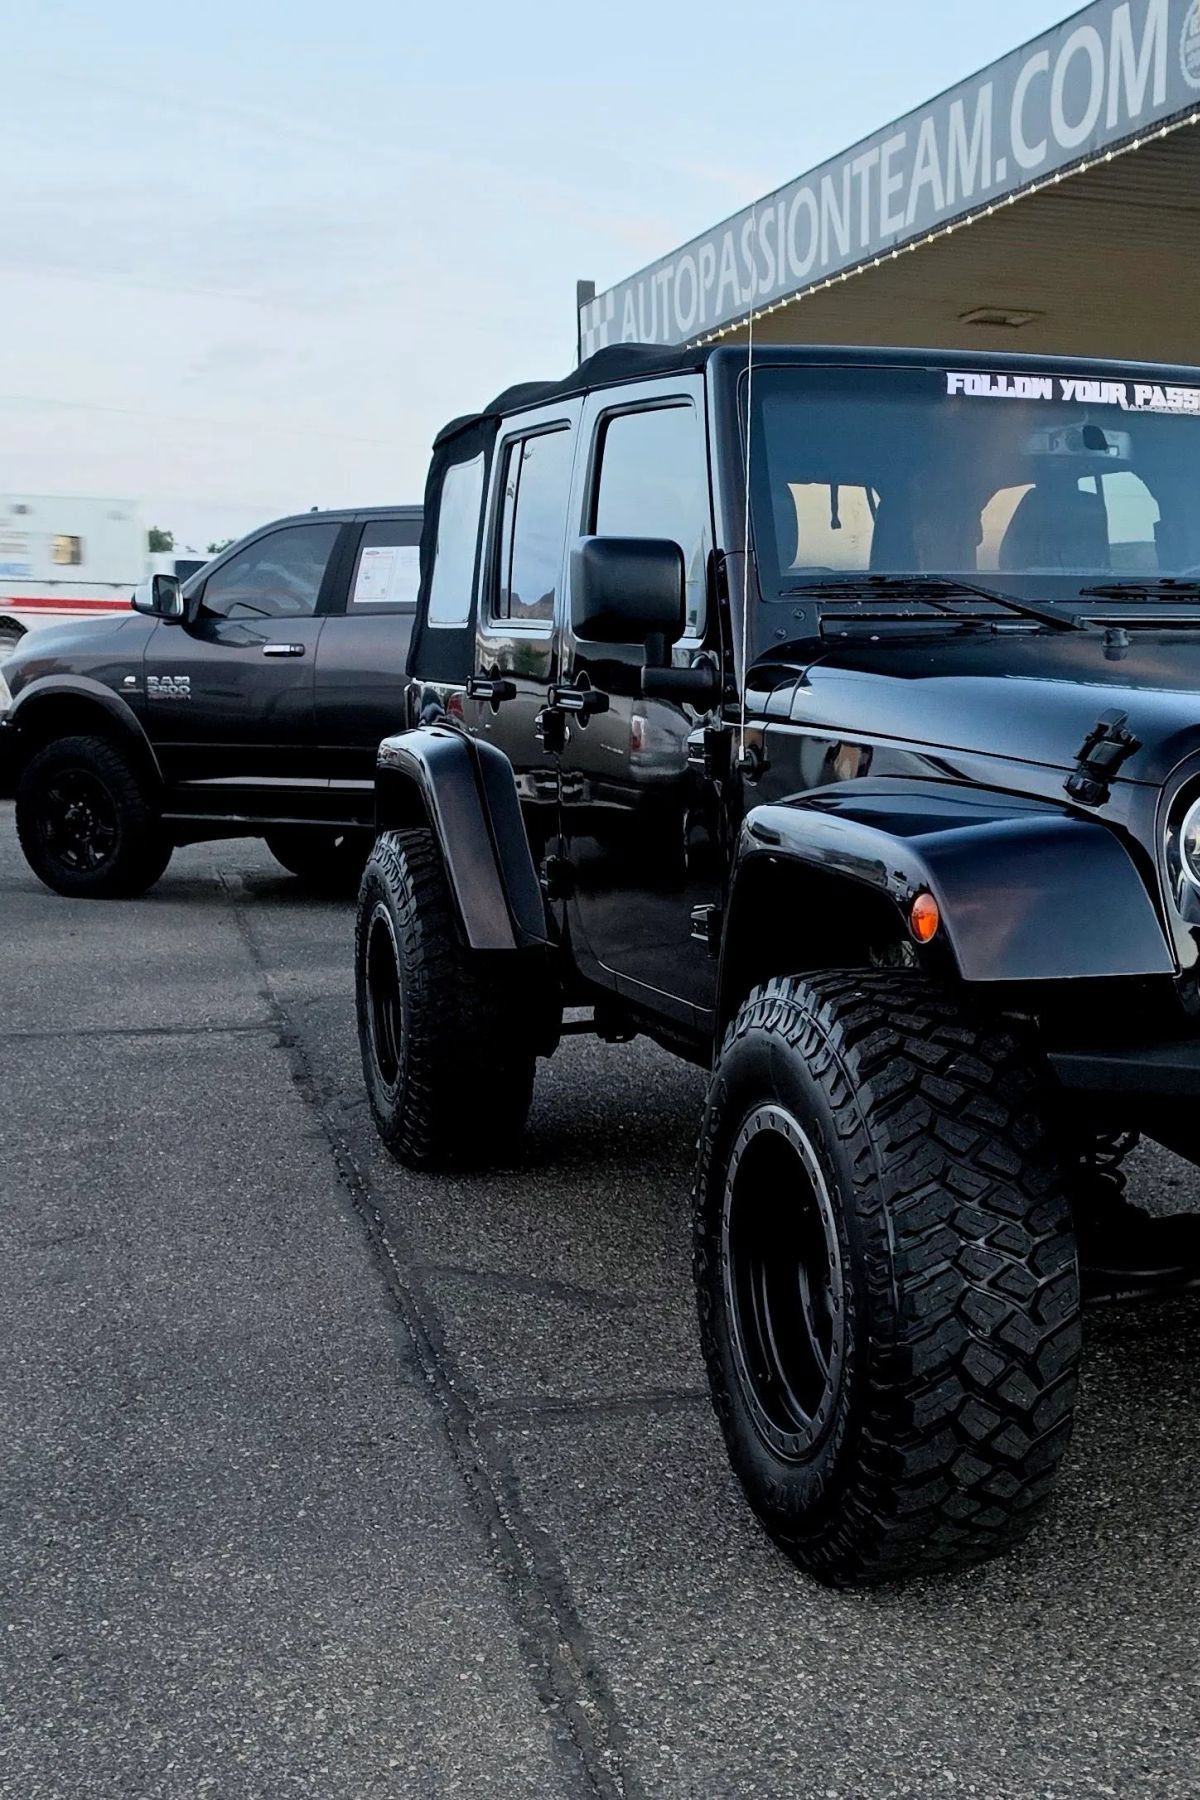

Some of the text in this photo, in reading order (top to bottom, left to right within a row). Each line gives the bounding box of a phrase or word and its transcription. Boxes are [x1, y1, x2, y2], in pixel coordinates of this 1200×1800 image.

[620, 0, 1168, 346] AUTOPASSIONTEAM.COM
[946, 372, 1052, 400] FOLLOW
[1059, 379, 1128, 410] YOUR
[146, 675, 190, 686] RAM
